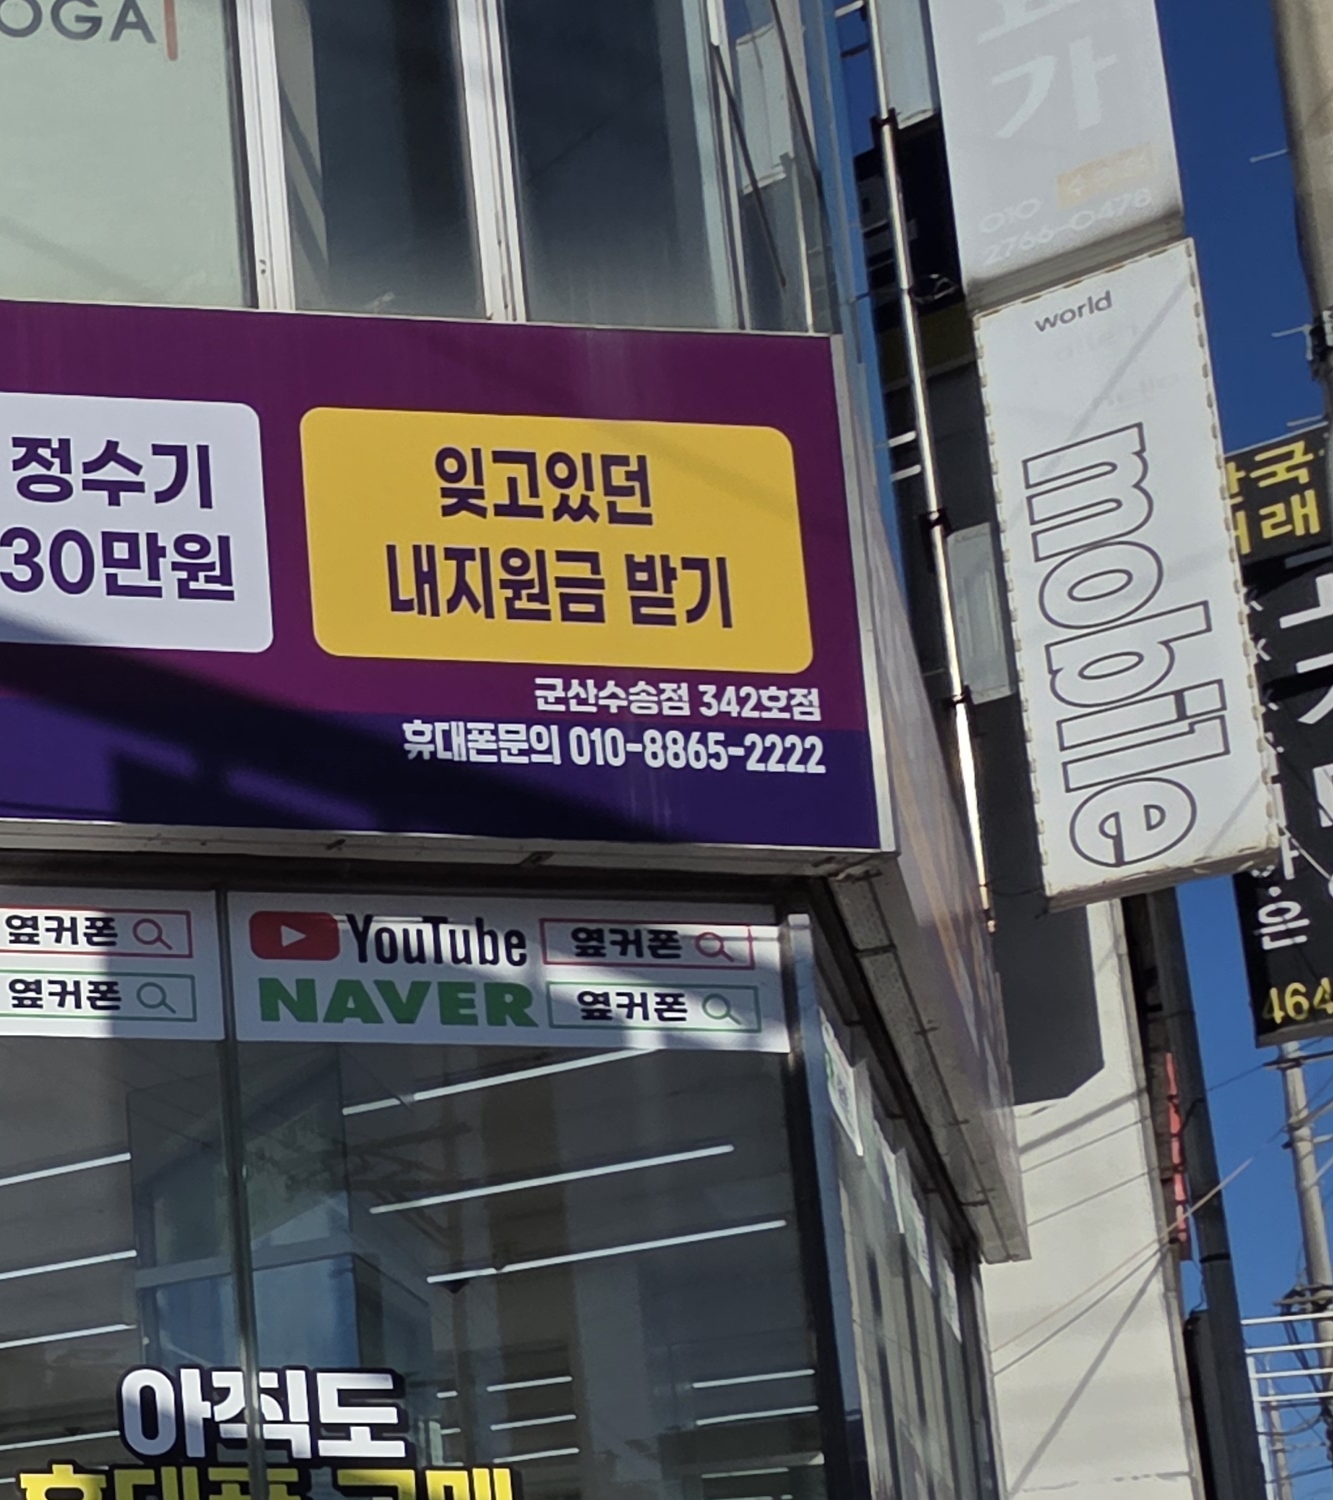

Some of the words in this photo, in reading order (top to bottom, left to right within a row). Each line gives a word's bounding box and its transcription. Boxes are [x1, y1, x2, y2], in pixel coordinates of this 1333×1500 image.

[1034, 290, 1113, 333] world
[11, 436, 215, 509] 정수기
[434, 445, 655, 527] 잊고있던
[384, 544, 608, 625] 내지원금
[625, 554, 734, 629] 받기
[1022, 422, 1230, 868] mobile
[533, 677, 691, 718] 군산수송점
[698, 684, 822, 723] 342호점
[403, 720, 562, 767] 휴대폰문의
[569, 726, 826, 776] 010-8865-2222
[6, 914, 118, 948] 옆커폰
[346, 914, 527, 967] YouTube
[571, 927, 683, 959] 옆커폰
[8, 978, 122, 1012] 옆커폰
[258, 977, 538, 1028] NAVER
[576, 991, 688, 1023] 옆커폰
[121, 1368, 406, 1459] 아직도
